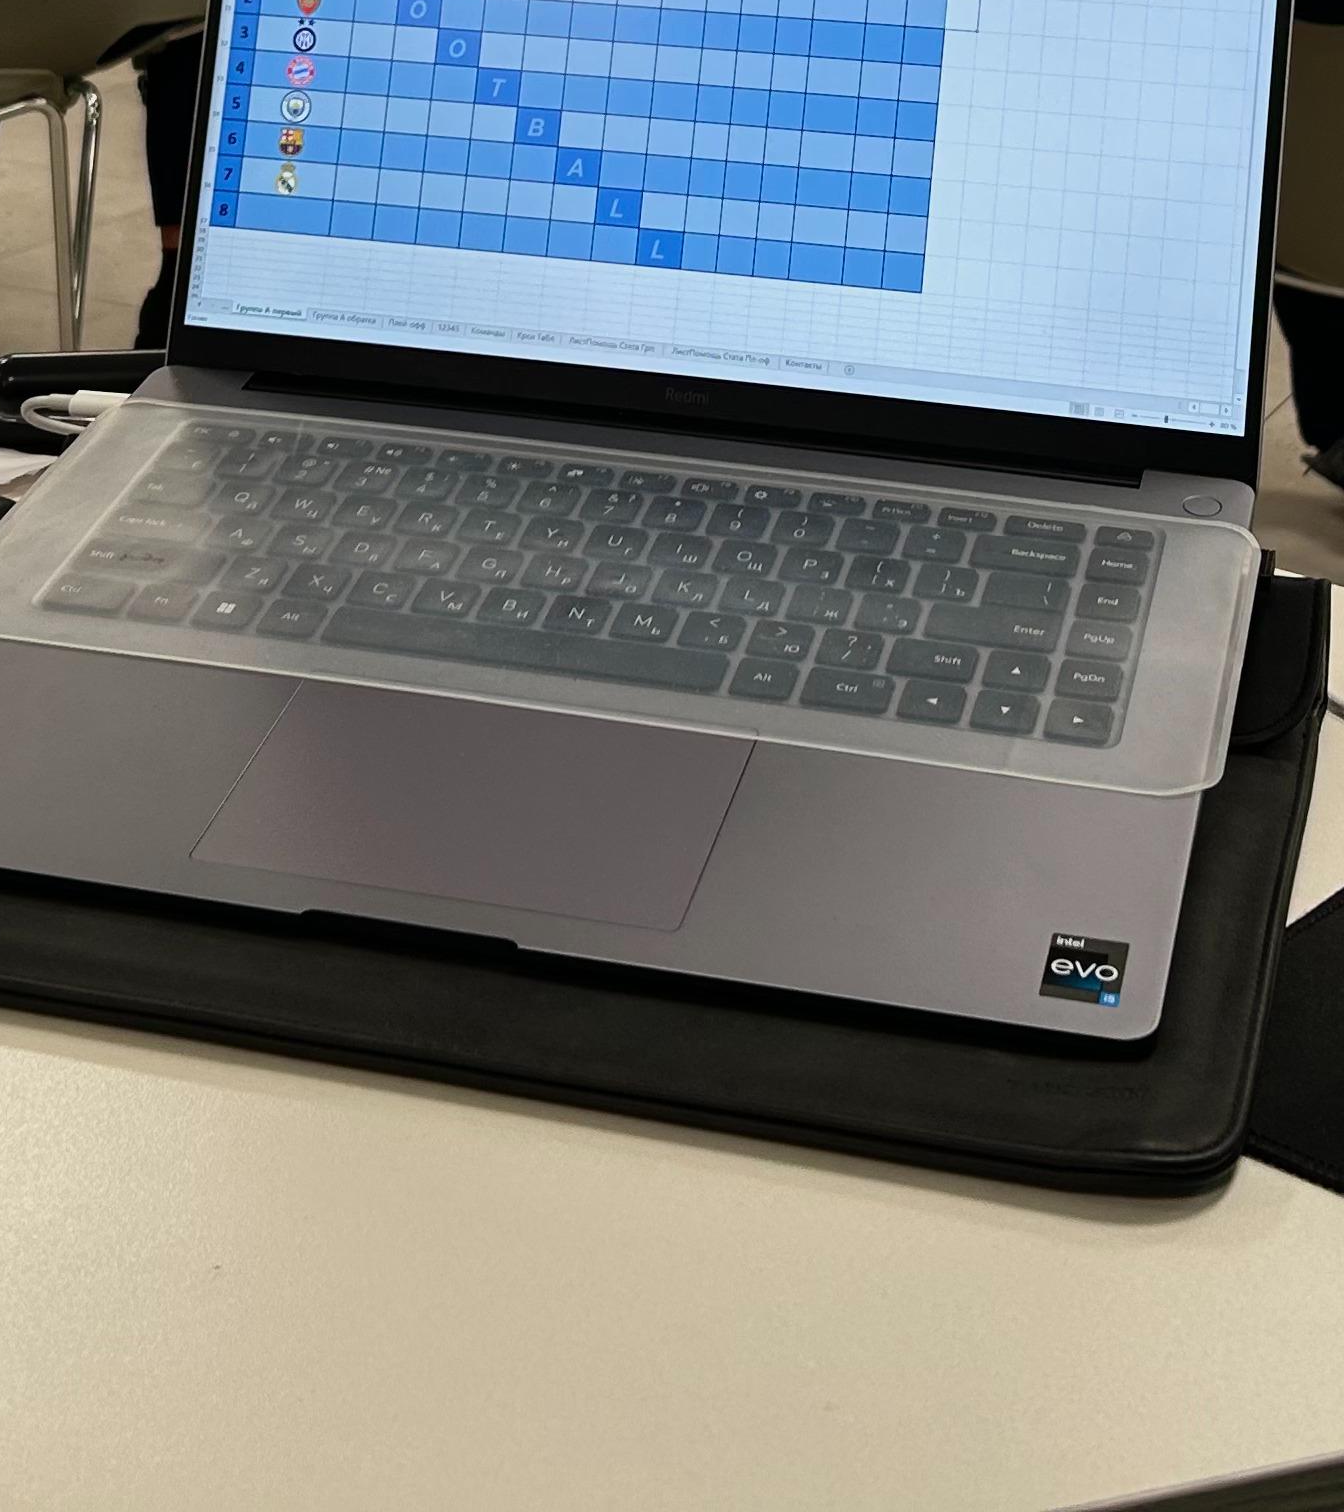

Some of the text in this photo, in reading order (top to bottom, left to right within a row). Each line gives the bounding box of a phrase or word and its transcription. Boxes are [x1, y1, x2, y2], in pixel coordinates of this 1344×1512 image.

[409, 0, 428, 19] O
[239, 26, 467, 58] 3 O
[235, 61, 507, 97] 4 T
[232, 96, 545, 137] 5 B
[227, 131, 585, 179] 6 A
[223, 167, 624, 218] 7 L
[219, 203, 665, 260] 8 L
[1027, 520, 1064, 532] Delete
[1011, 548, 1067, 562] Backspace
[1100, 559, 1134, 570] Home
[1096, 596, 1119, 607] End
[280, 611, 299, 622] Alt
[1013, 625, 1045, 637] Enter
[933, 654, 962, 666] Shift
[753, 671, 771, 682] Alt
[1073, 671, 1106, 686] PgDn
[836, 682, 858, 694] Ctrl
[1056, 935, 1085, 949] intel
[1050, 958, 1119, 982] evo
